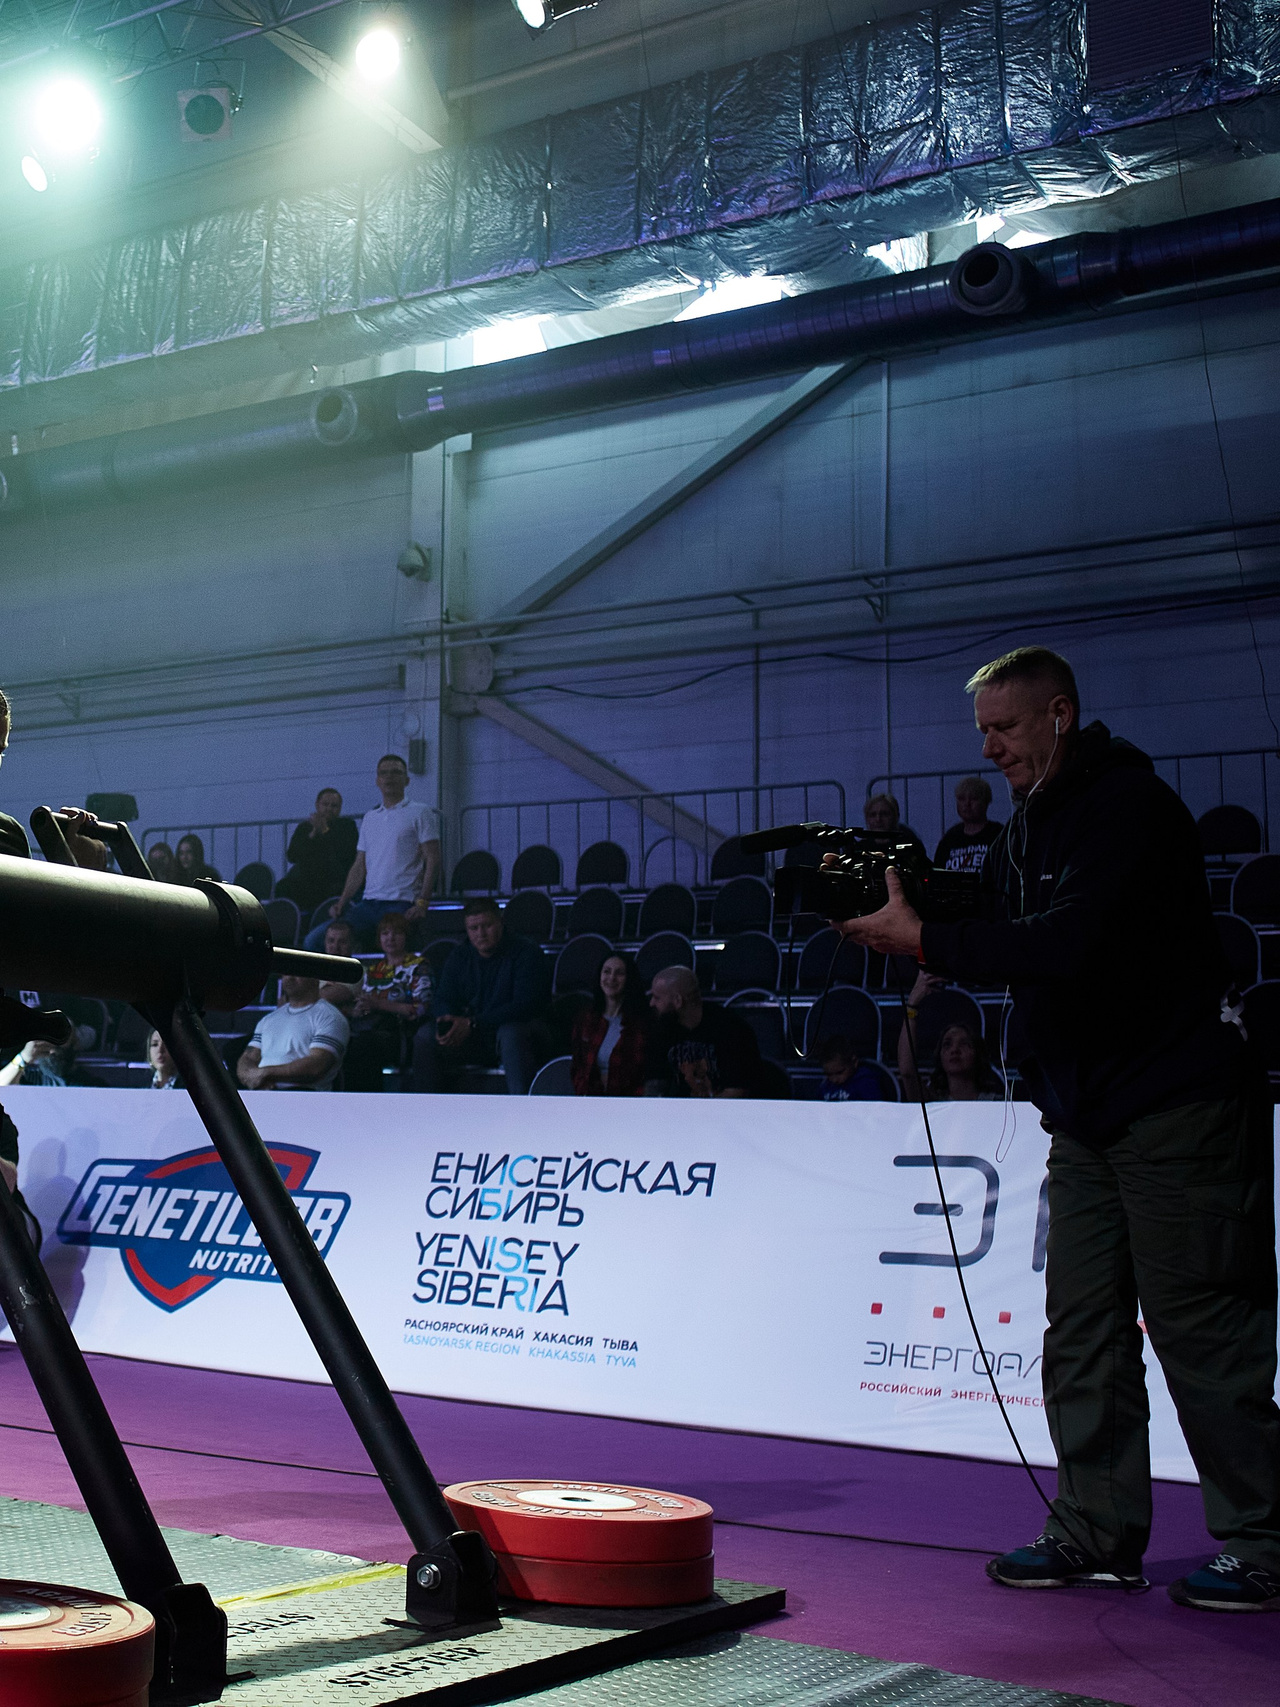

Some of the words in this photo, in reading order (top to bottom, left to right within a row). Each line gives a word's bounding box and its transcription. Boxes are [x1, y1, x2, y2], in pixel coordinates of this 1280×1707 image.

[429, 1150, 717, 1198] ЕНИСЕЙСКАЯ
[425, 1186, 585, 1228] СИБИРЬ
[188, 1249, 280, 1277] NUTRIT
[414, 1232, 581, 1278] YENISEY
[412, 1269, 570, 1317] SIBERIA
[474, 1342, 521, 1356] REGION
[528, 1346, 597, 1365] KHAKASSIA
[606, 1354, 637, 1369] TYVA
[491, 1326, 525, 1341] КРАЙ
[532, 1331, 594, 1348] ХАКАСИЯ
[602, 1338, 639, 1353] ТЫВА
[859, 1380, 943, 1398] РОССИЙСКИЙ
[15, 1587, 103, 1610] AGAIN
[328, 1647, 491, 1688] STECTER
